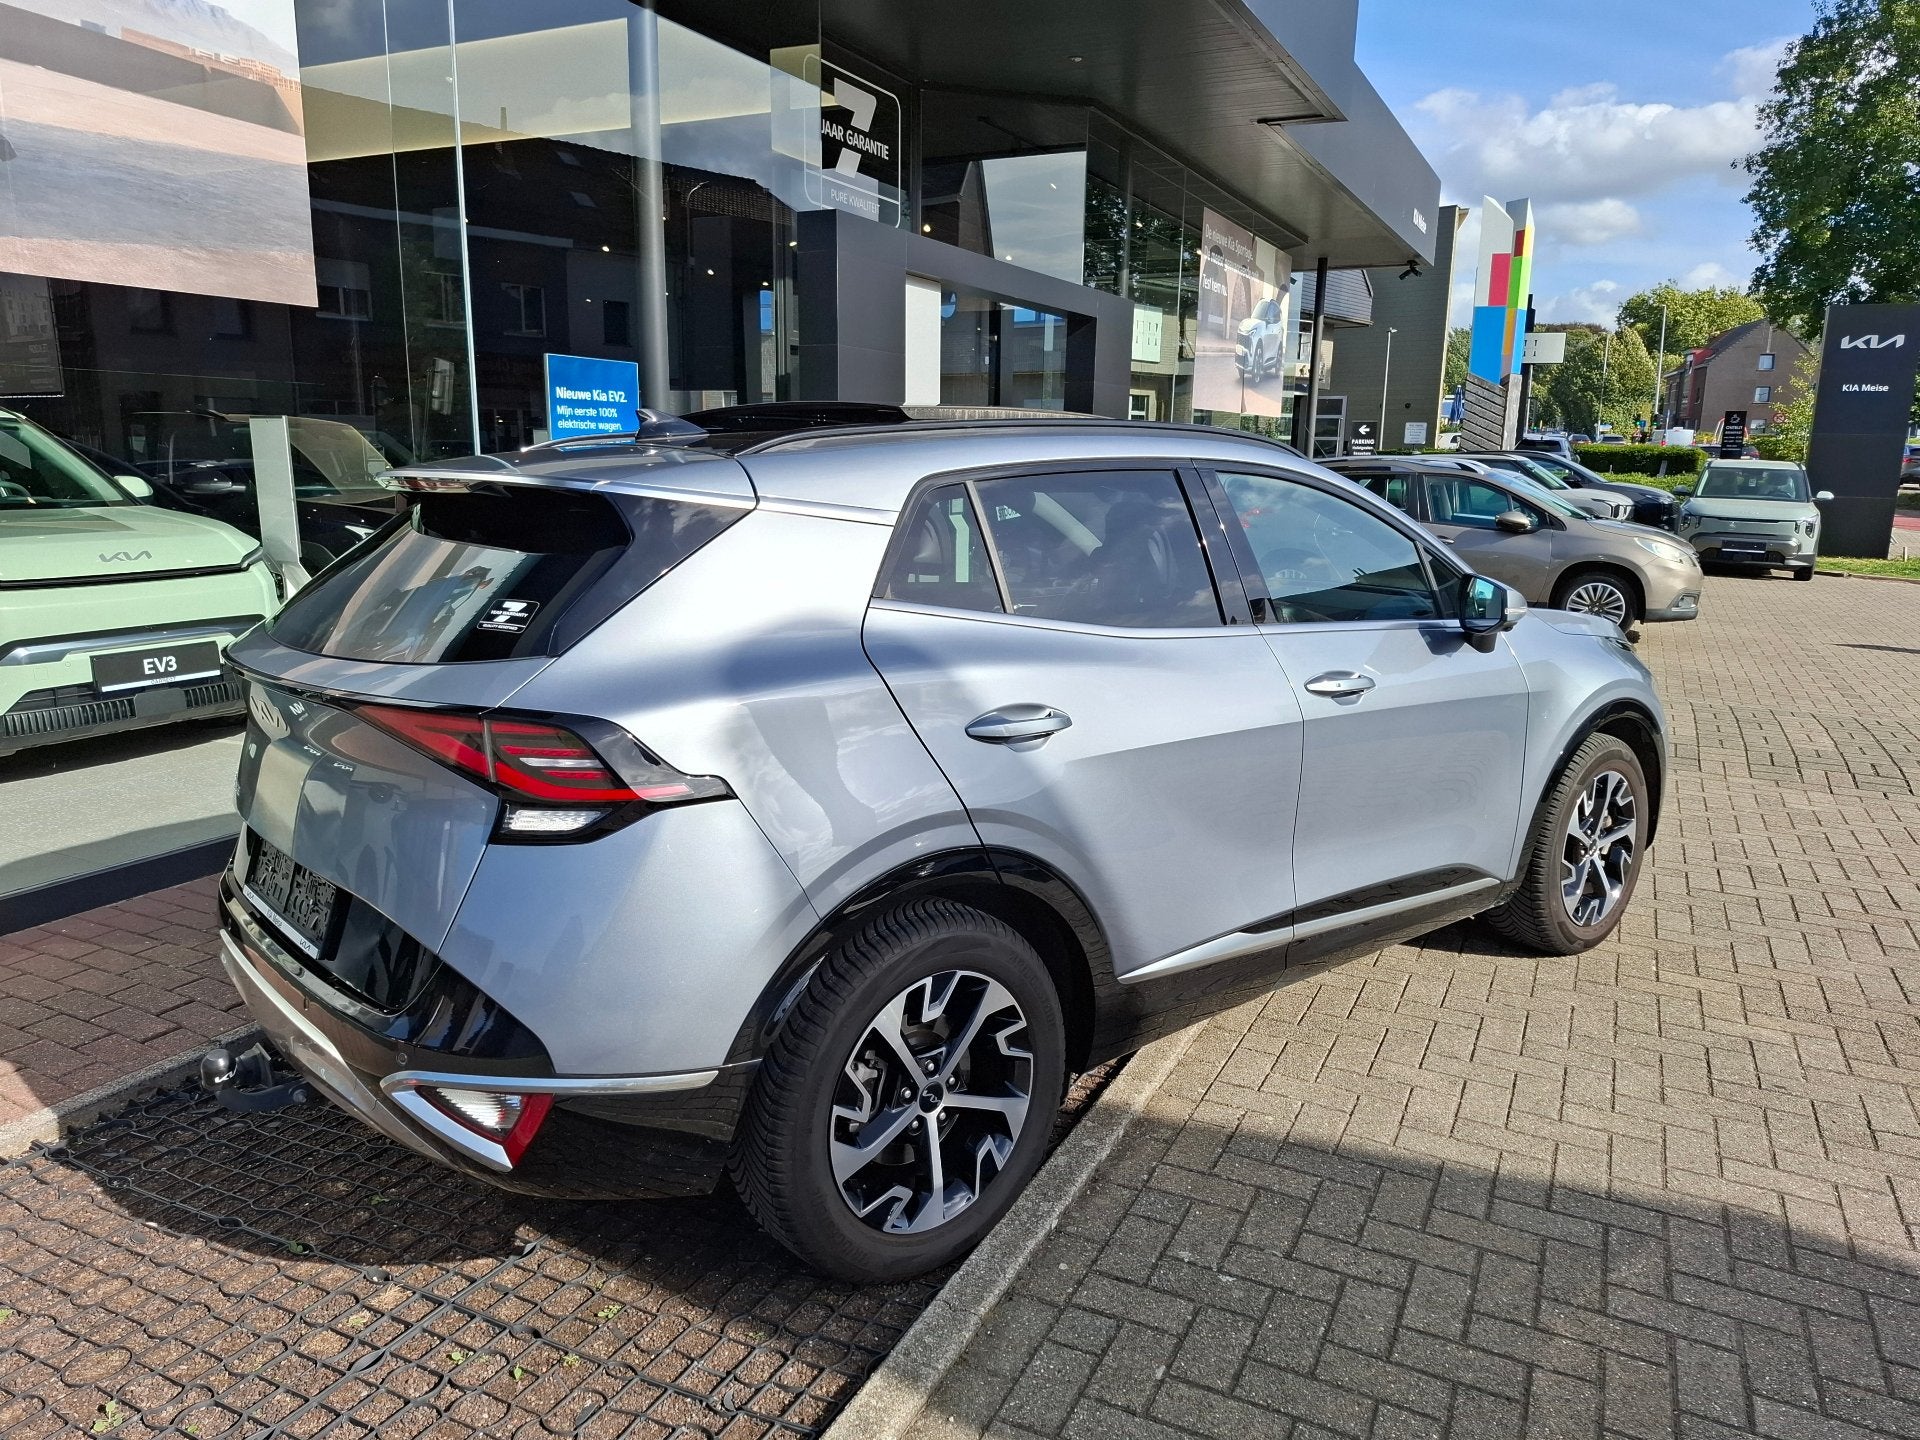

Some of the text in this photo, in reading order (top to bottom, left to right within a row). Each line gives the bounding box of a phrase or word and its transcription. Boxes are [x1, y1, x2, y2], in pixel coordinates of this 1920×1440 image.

[821, 119, 889, 161] JAAR GARANTIE
[831, 189, 880, 214] PURE KWALITEIT
[1205, 224, 1212, 240] De
[1213, 229, 1228, 247] nieuwe
[1203, 274, 1211, 290] Test
[1841, 334, 1905, 349] KIA
[556, 386, 628, 403] Nieuwe Kia EV2.
[1842, 384, 1889, 392] KIA Meise
[556, 405, 617, 418] Mijn eerste 100%
[558, 419, 622, 432] elektrische wagen.
[99, 550, 152, 563] KIA
[143, 655, 177, 675] EV3
